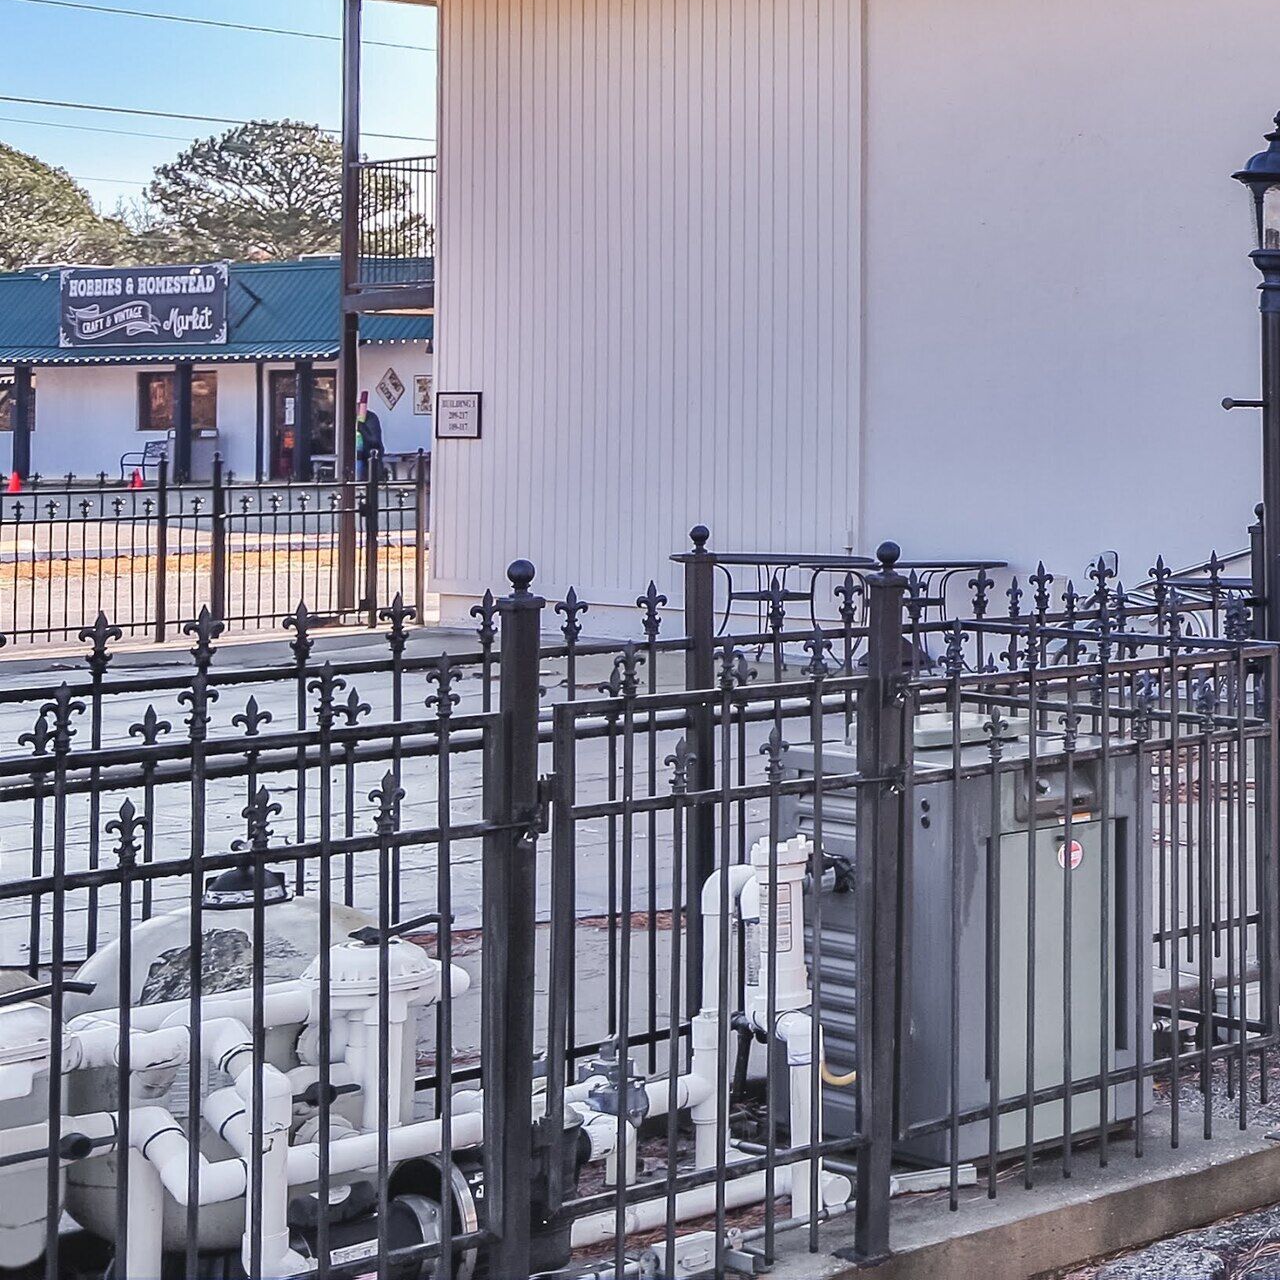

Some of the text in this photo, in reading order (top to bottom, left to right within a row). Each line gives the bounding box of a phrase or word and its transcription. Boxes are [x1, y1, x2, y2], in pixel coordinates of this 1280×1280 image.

[69, 275, 216, 297] HOBBIES & HOMESTEAD
[82, 306, 143, 334] CRAFT & VINTAGE
[163, 306, 212, 338] Market
